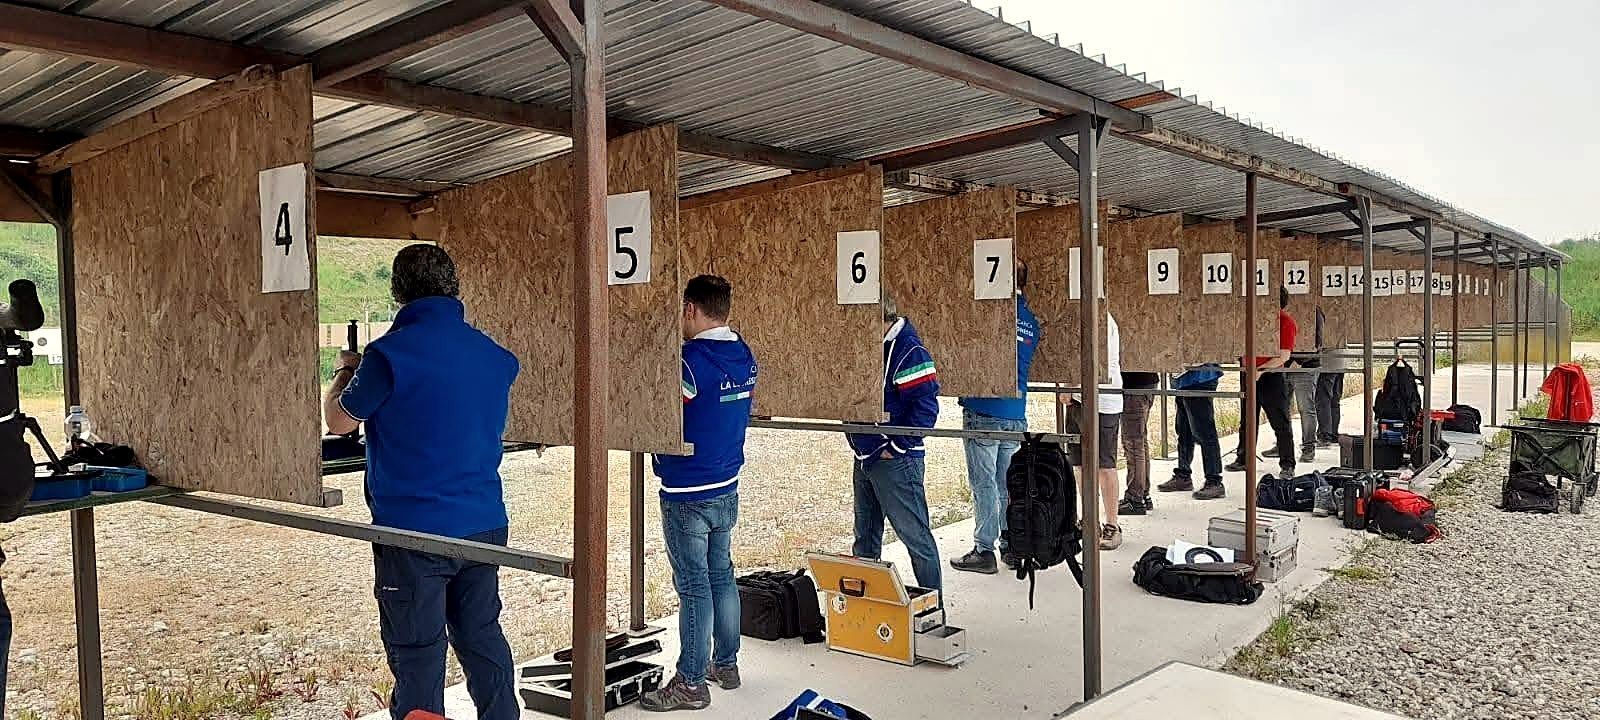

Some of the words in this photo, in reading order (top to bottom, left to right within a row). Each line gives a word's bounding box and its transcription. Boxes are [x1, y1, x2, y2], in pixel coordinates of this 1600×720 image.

[275, 202, 292, 256] 4
[614, 226, 638, 279] 5
[851, 252, 867, 284] 6
[986, 256, 1000, 283] 7
[1157, 261, 1169, 282] 9
[1207, 264, 1229, 283] 10
[1256, 270, 1265, 286] 1
[1288, 270, 1306, 285] 12
[1326, 274, 1343, 288] 13
[1374, 277, 1389, 289] 15
[1391, 276, 1404, 286] 16
[1410, 276, 1424, 287] 17
[1440, 280, 1451, 290] 19
